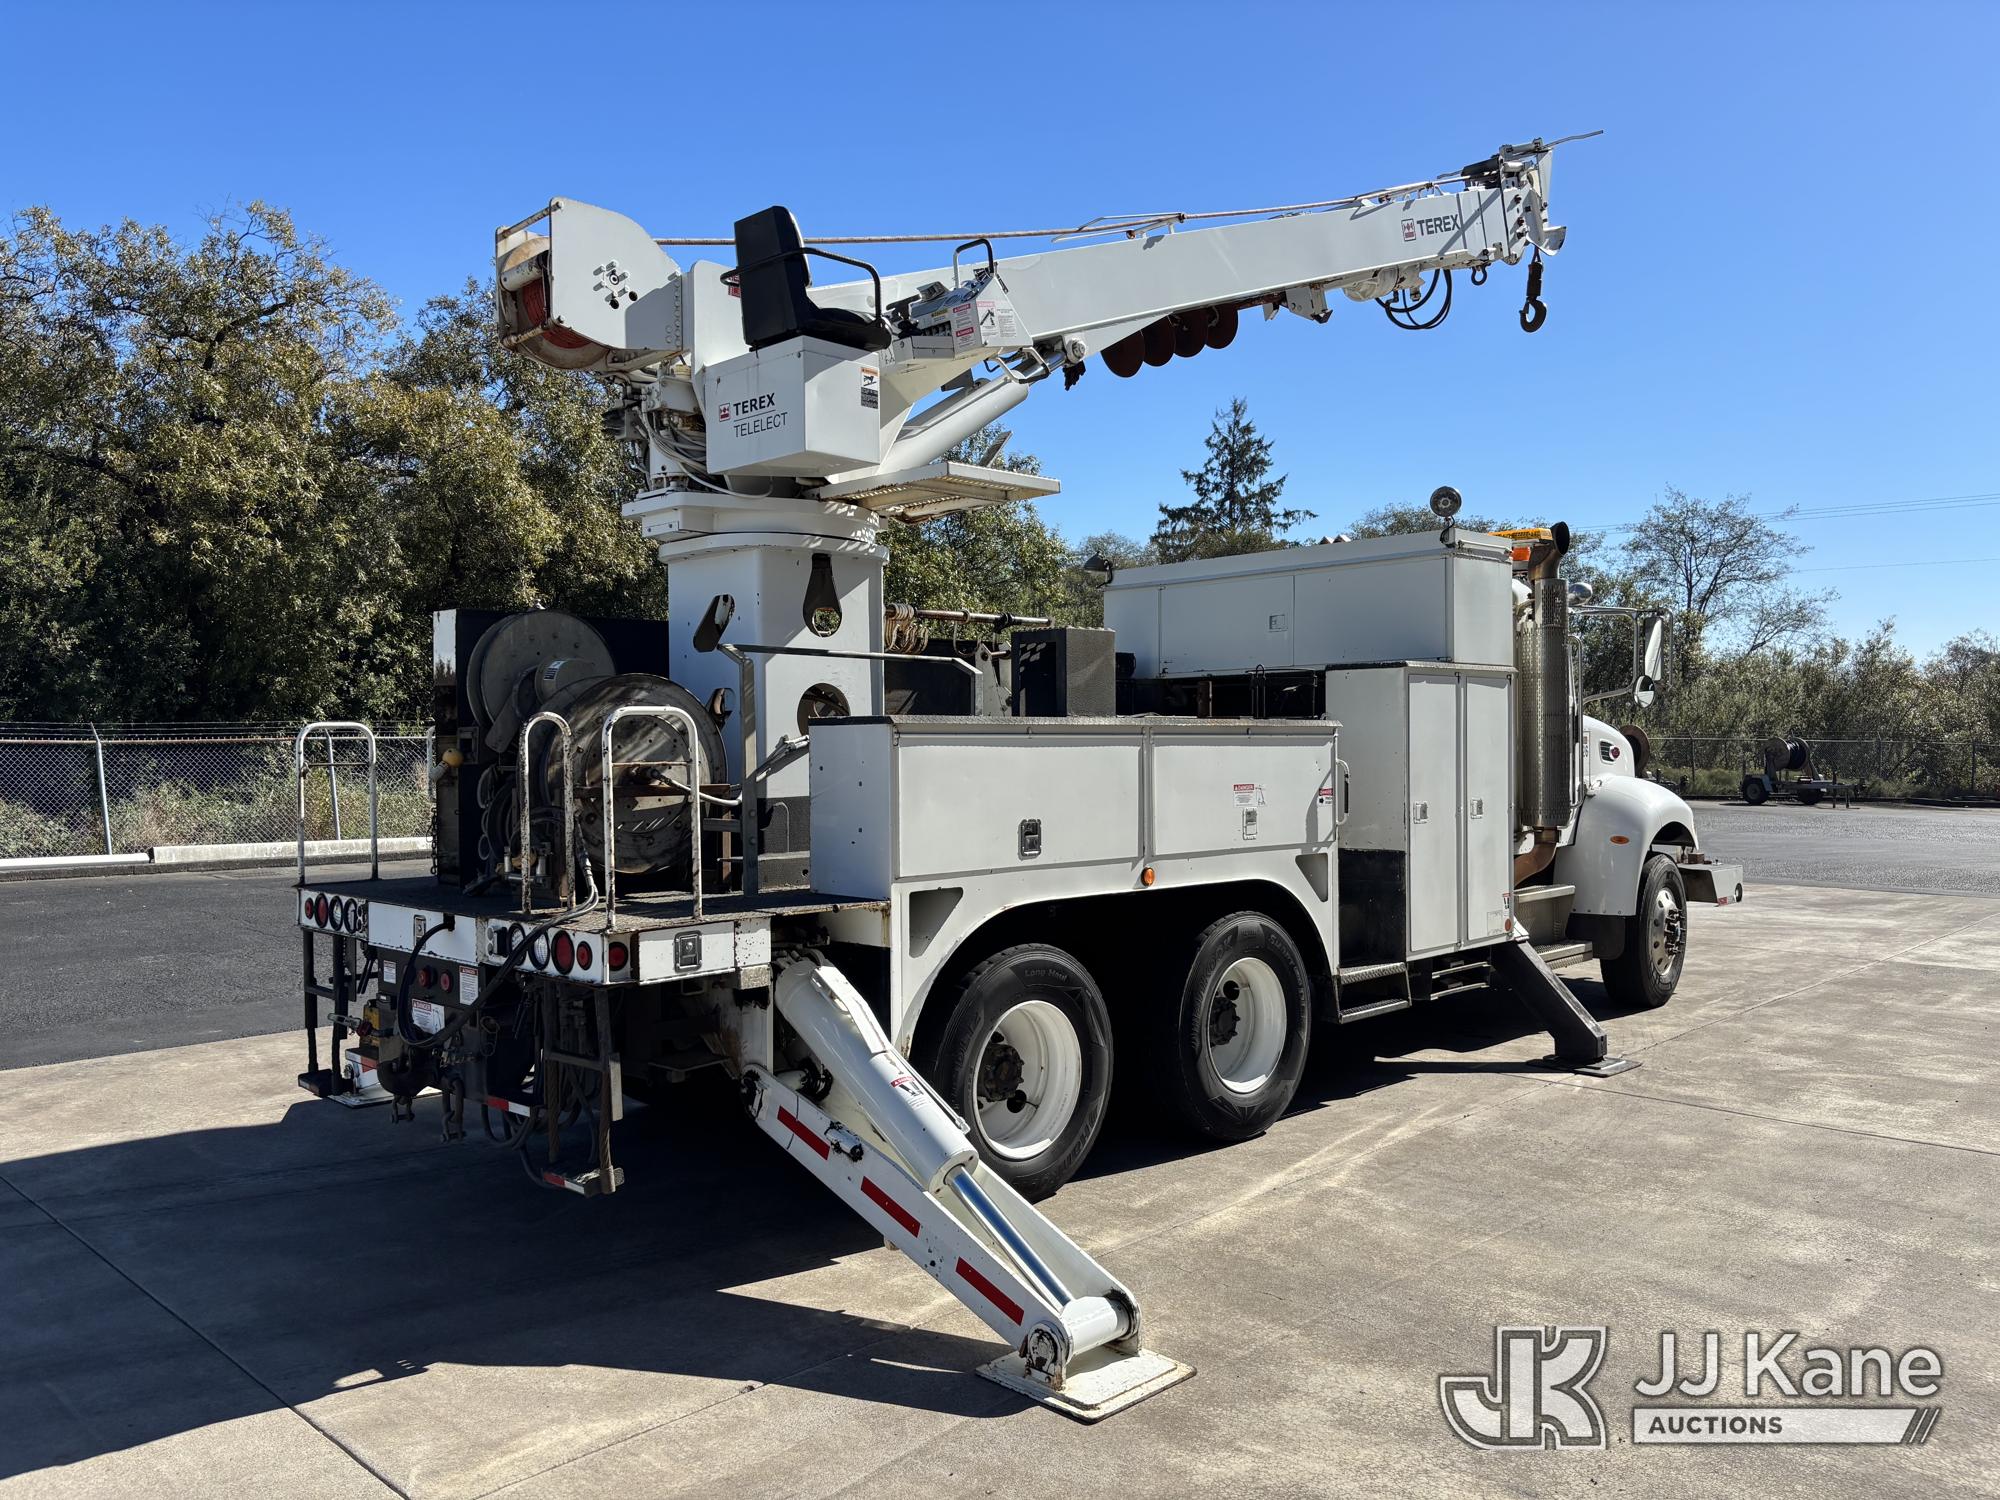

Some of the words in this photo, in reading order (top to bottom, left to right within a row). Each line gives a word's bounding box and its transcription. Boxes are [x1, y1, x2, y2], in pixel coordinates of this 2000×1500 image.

[1417, 214, 1460, 236] TEREX
[733, 393, 775, 416] TEREX
[733, 412, 788, 437] TELELECT
